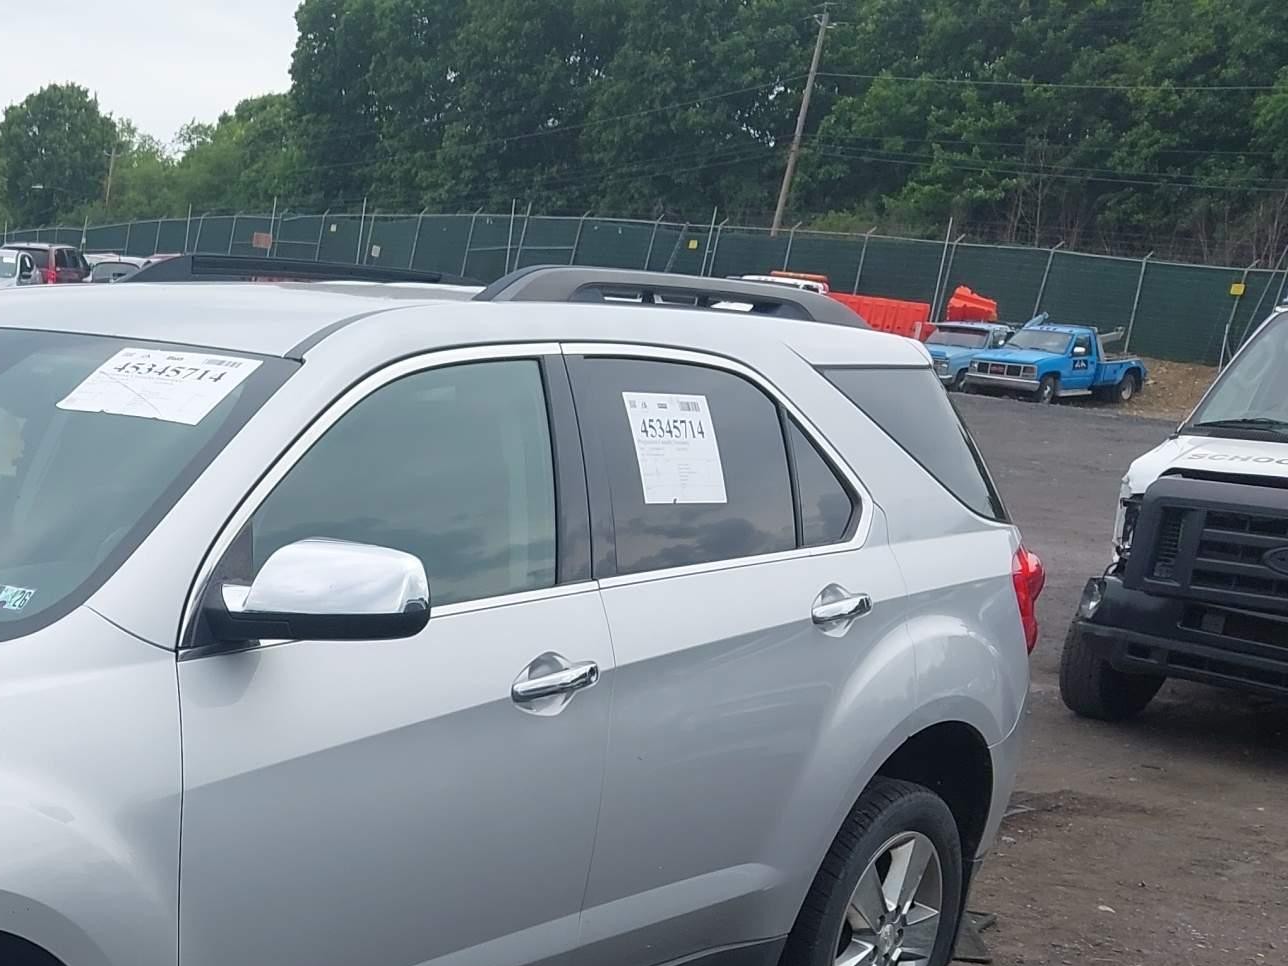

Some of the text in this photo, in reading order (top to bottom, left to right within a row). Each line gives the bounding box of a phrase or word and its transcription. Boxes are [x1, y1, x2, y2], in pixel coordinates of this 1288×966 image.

[113, 361, 228, 383] 45345714
[640, 417, 705, 440] 45345714
[12, 590, 33, 609] 26
